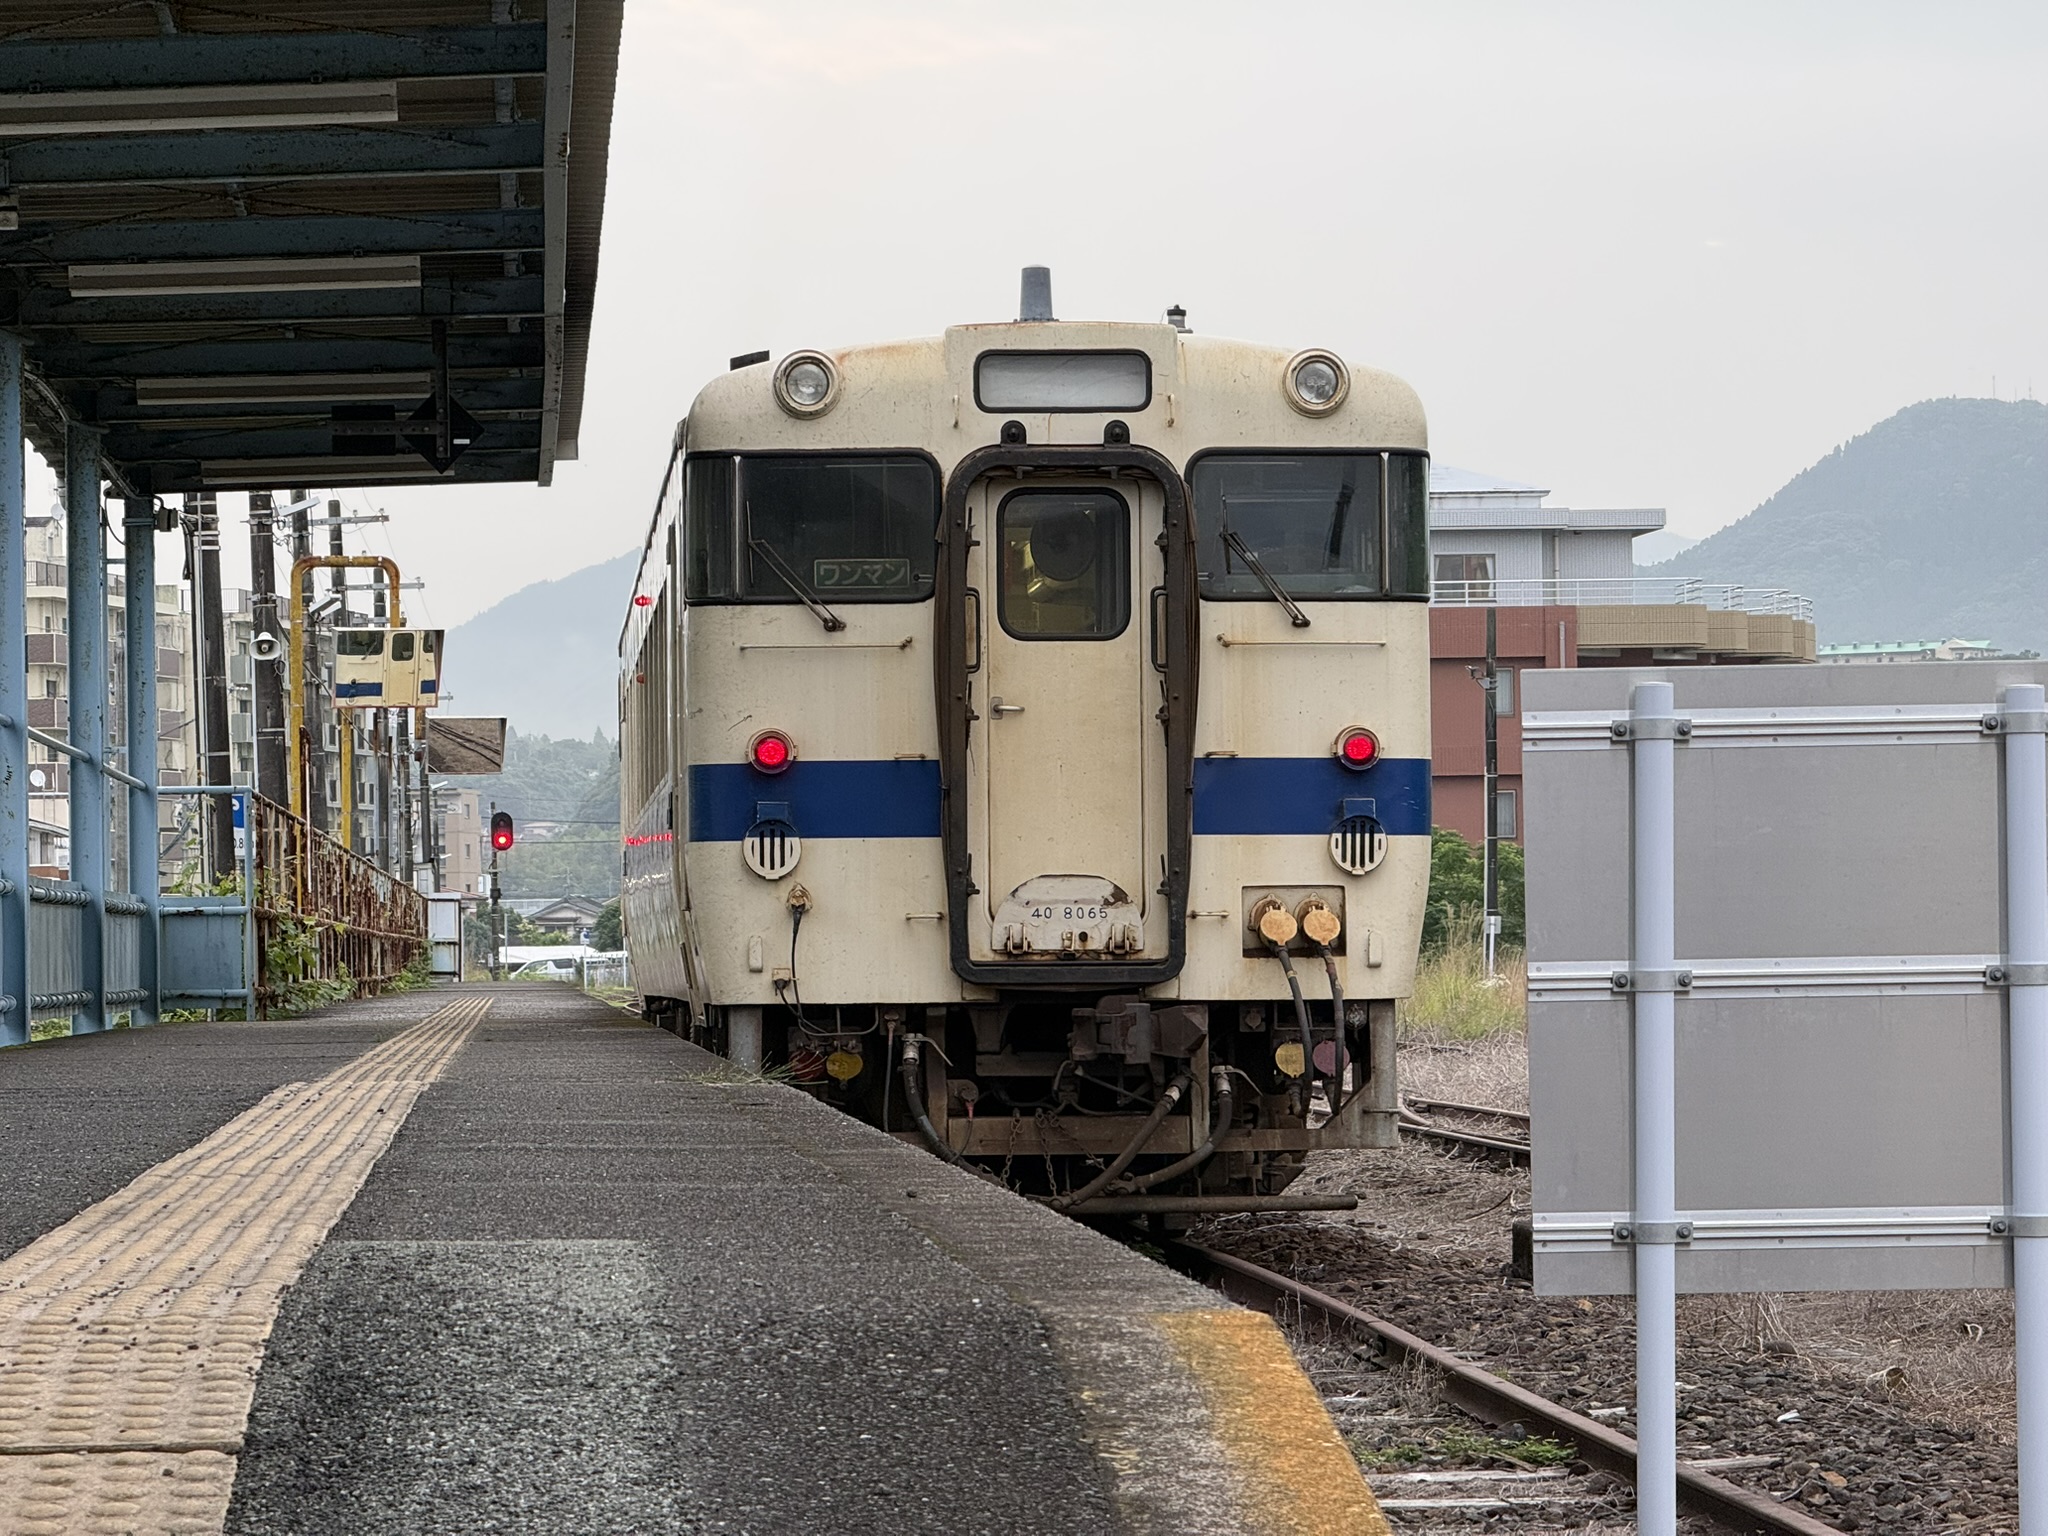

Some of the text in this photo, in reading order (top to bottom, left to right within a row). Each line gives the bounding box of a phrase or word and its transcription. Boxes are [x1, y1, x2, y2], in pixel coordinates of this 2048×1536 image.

[819, 563, 906, 585] ワンマン
[1031, 906, 1108, 920] 40 8065
